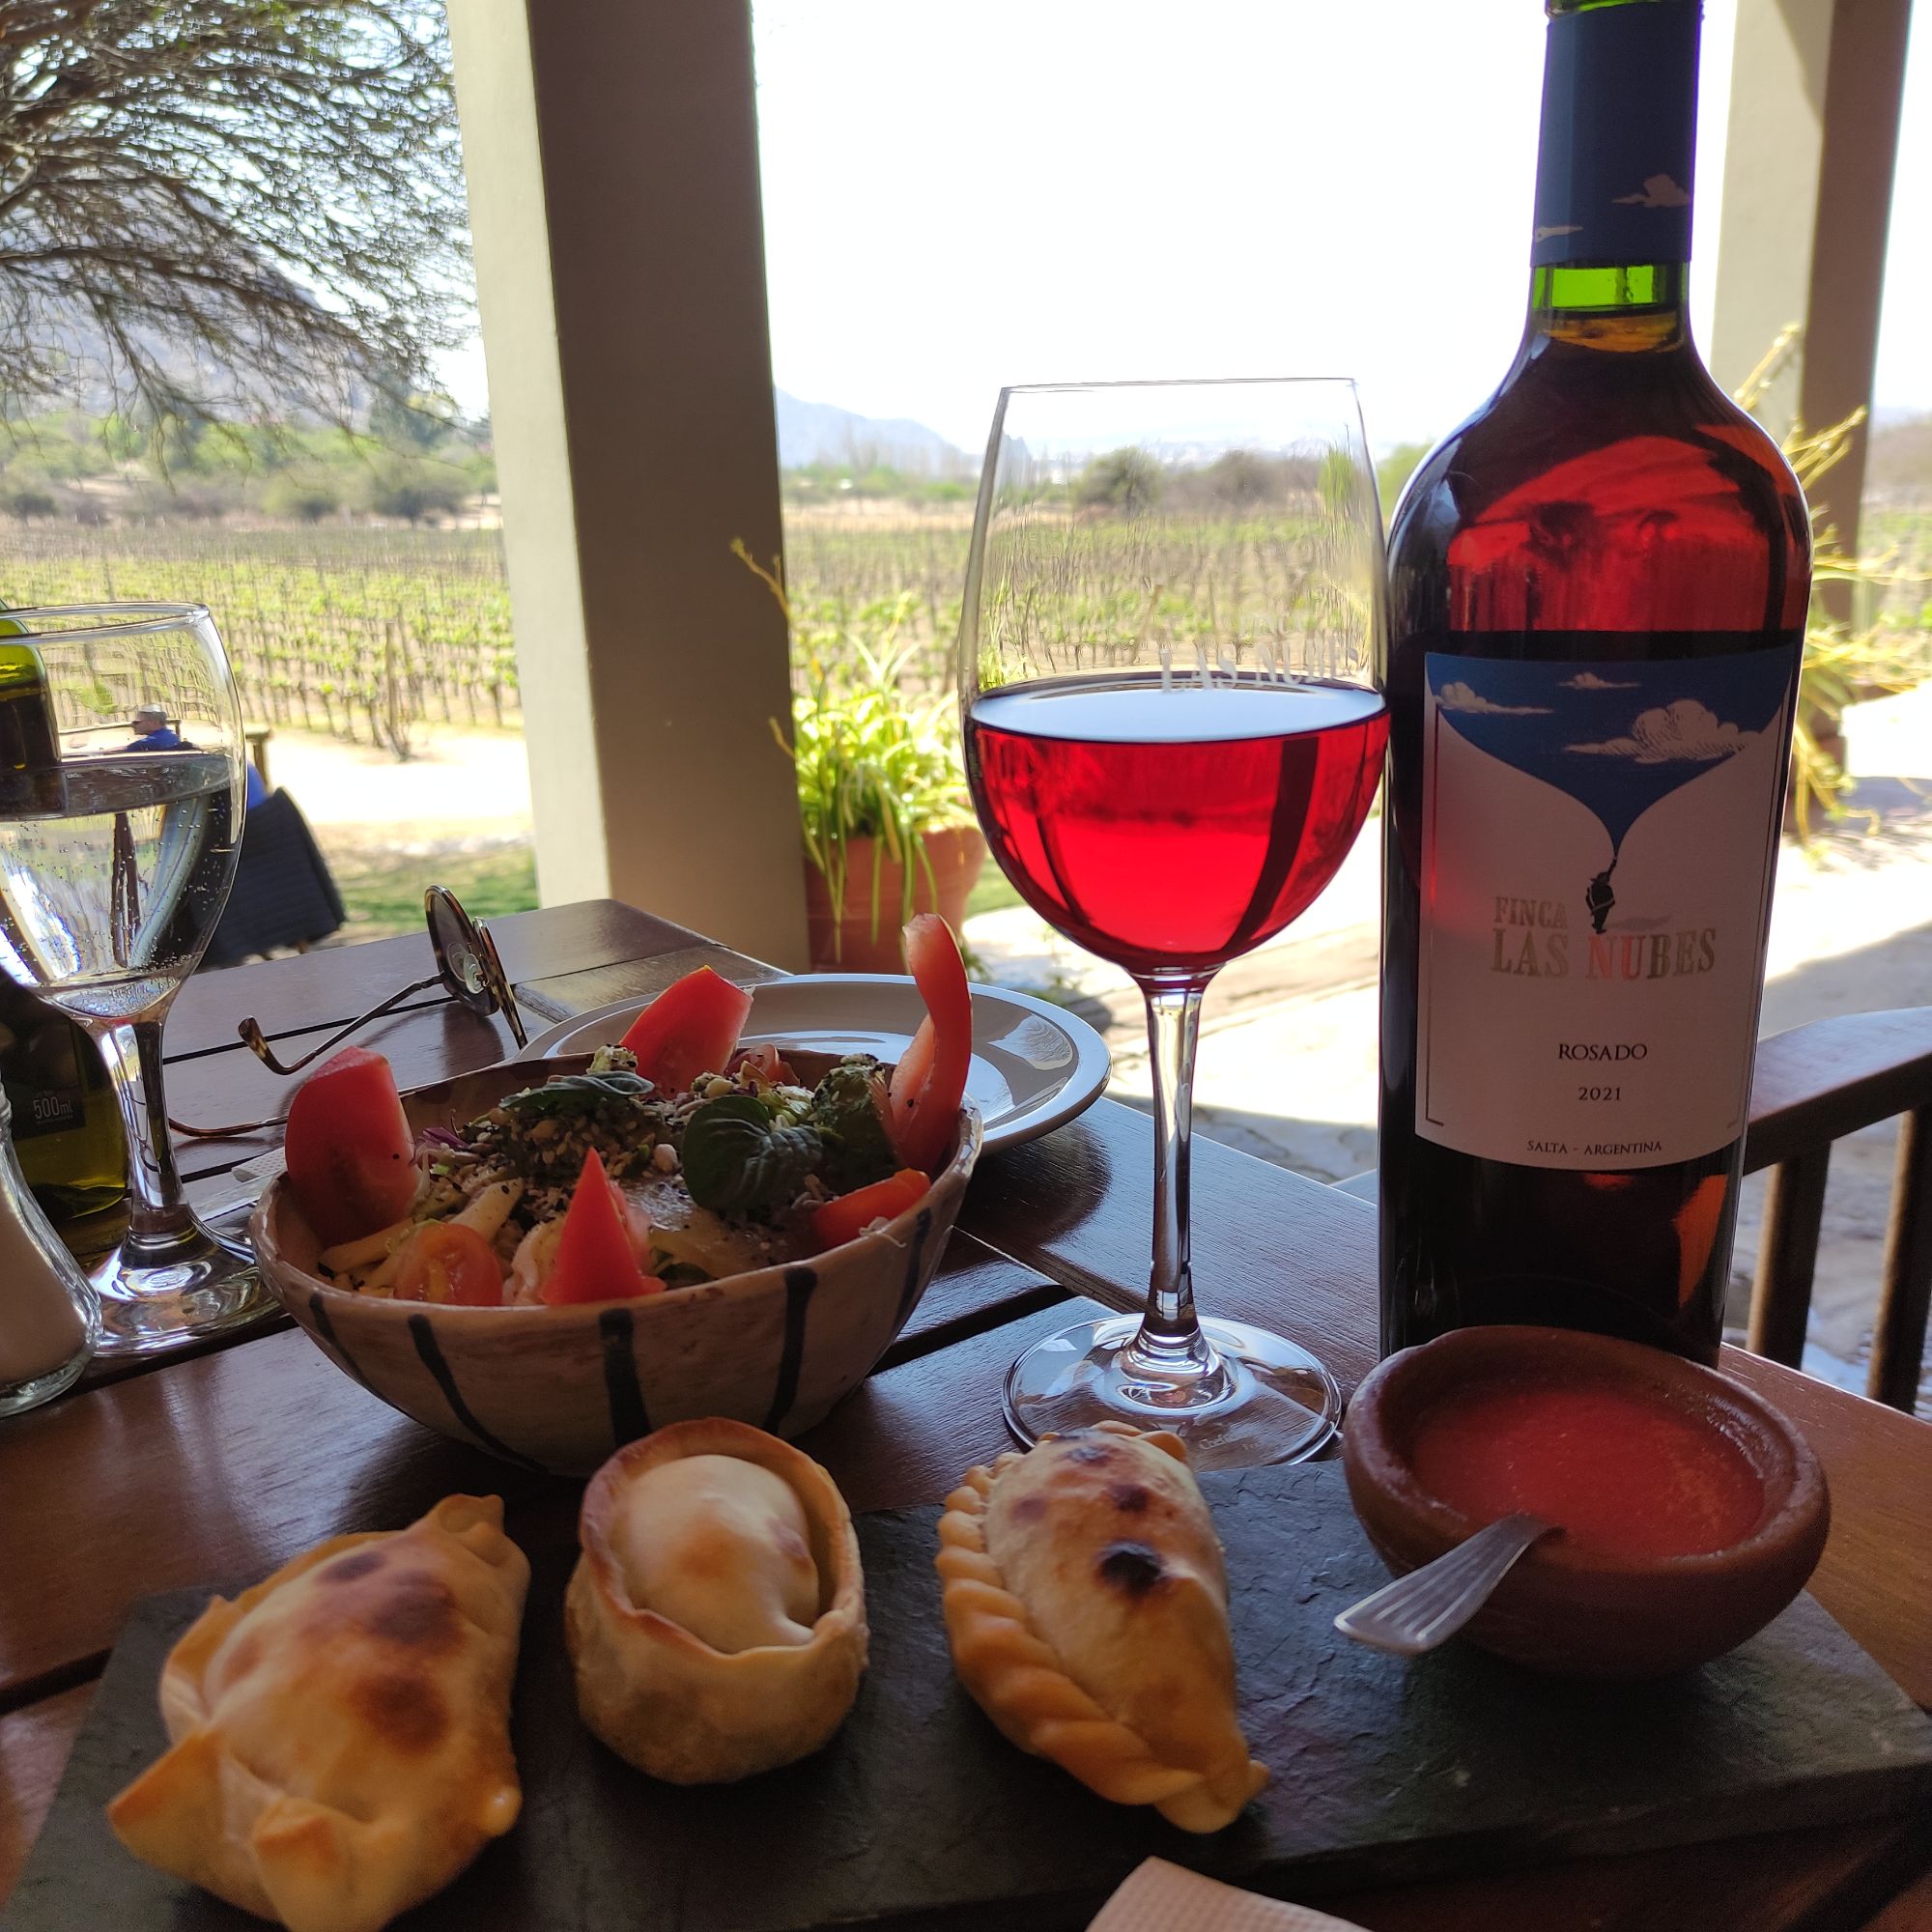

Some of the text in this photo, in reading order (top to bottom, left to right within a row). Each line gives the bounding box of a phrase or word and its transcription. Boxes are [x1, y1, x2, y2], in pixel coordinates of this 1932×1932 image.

[1494, 896, 1568, 929] FINCA
[1492, 928, 1717, 980] LAS NUBES
[1558, 1042, 1648, 1062] ROSADO
[1577, 1087, 1622, 1101] 2021
[1526, 1140, 1568, 1154] SALTA
[1584, 1140, 1662, 1156] ARGENTINA
